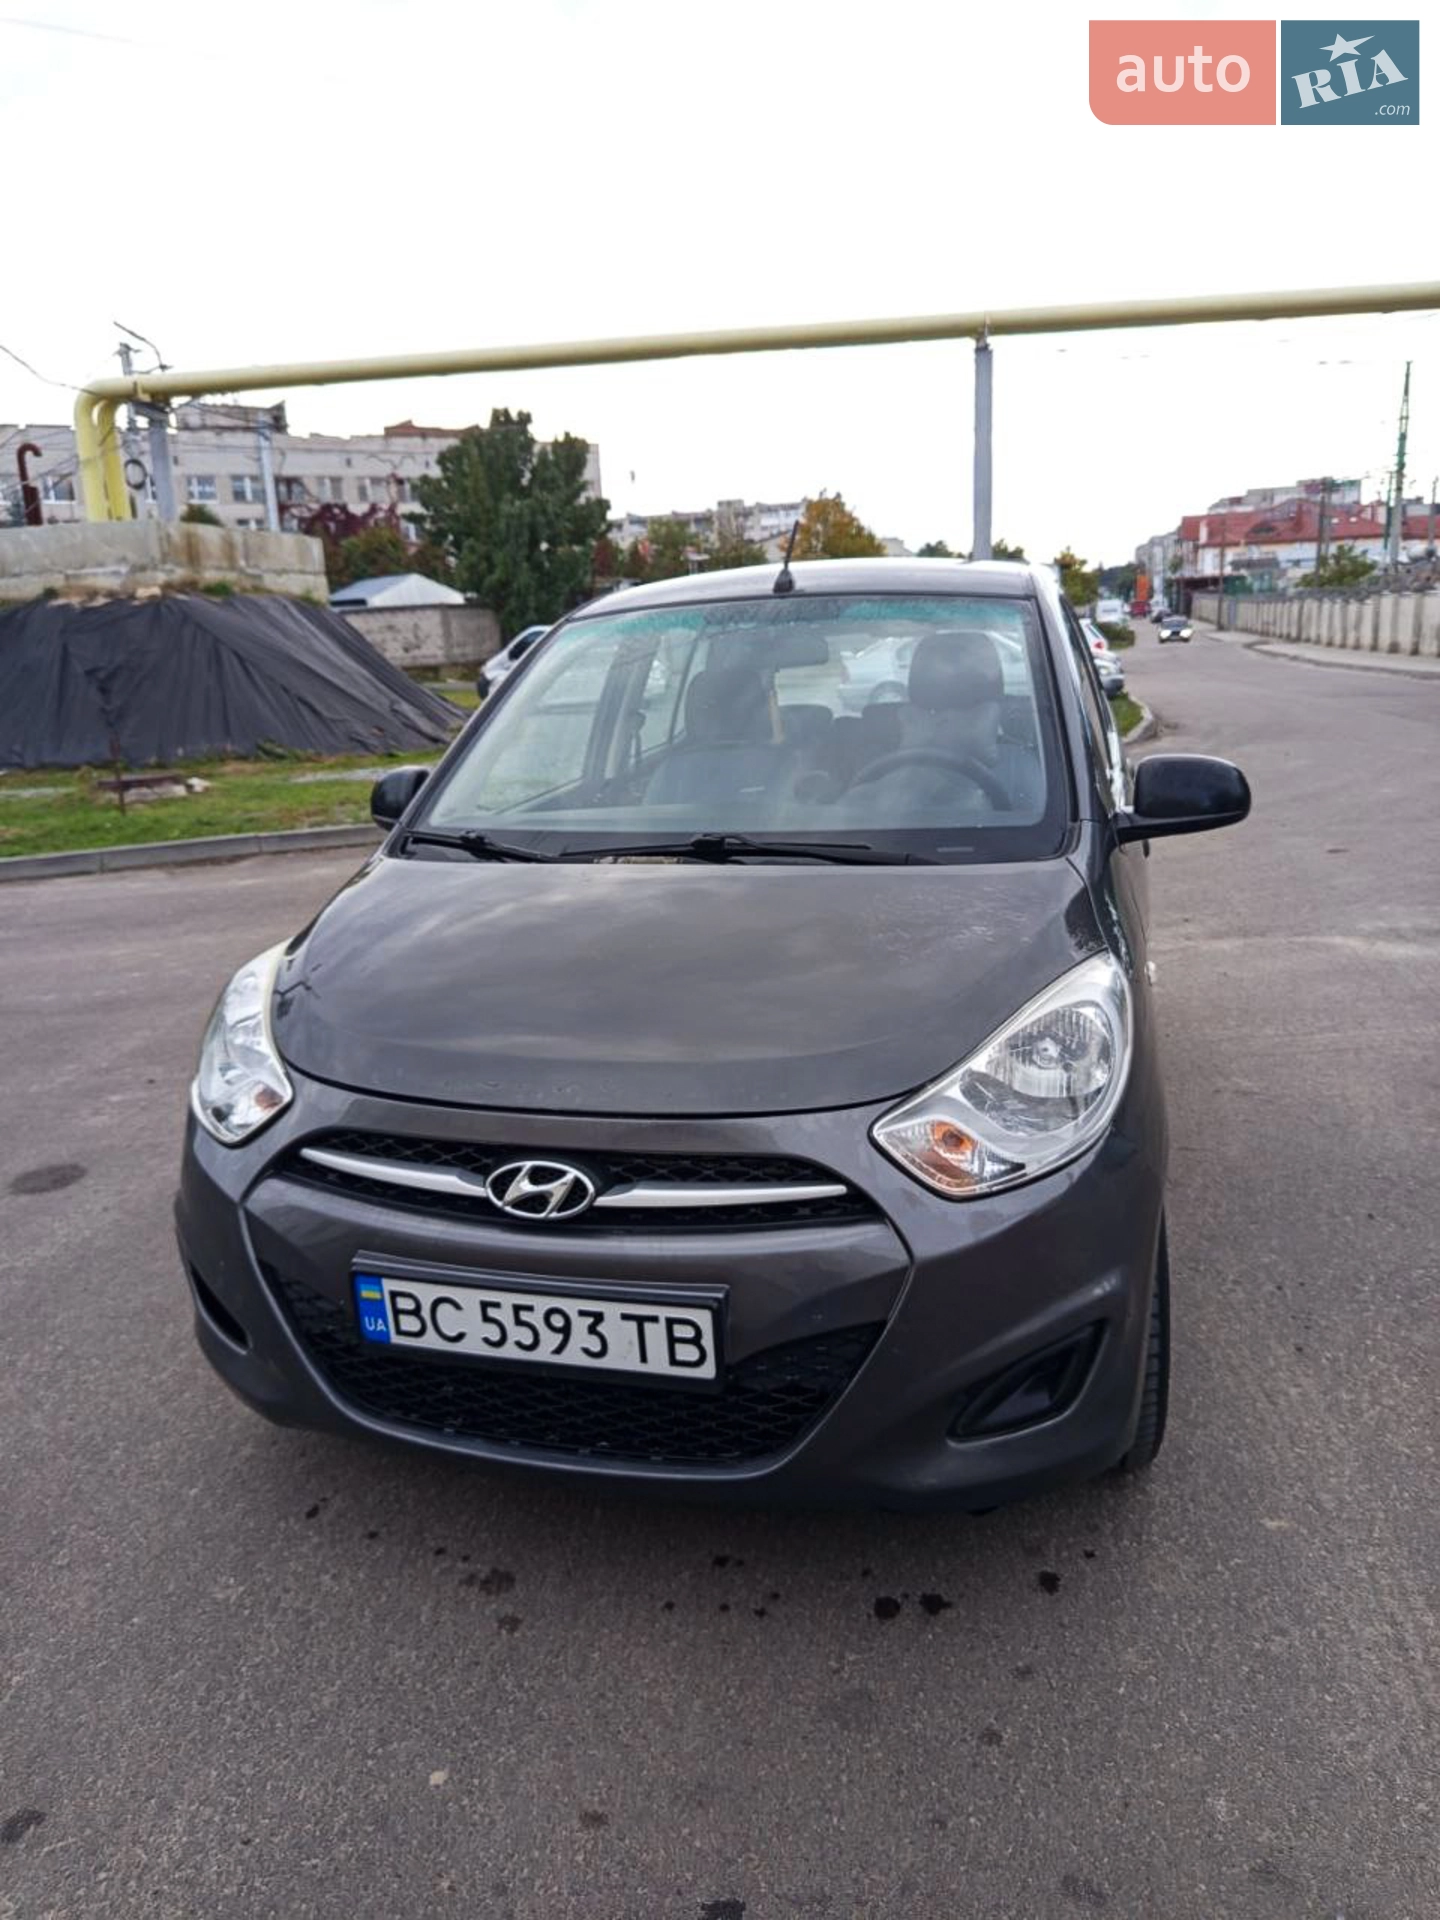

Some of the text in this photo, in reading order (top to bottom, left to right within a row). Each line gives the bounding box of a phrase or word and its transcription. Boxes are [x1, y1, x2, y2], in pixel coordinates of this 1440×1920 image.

[364, 1318, 387, 1333] UA
[388, 1289, 708, 1369] BC 5593 TB
